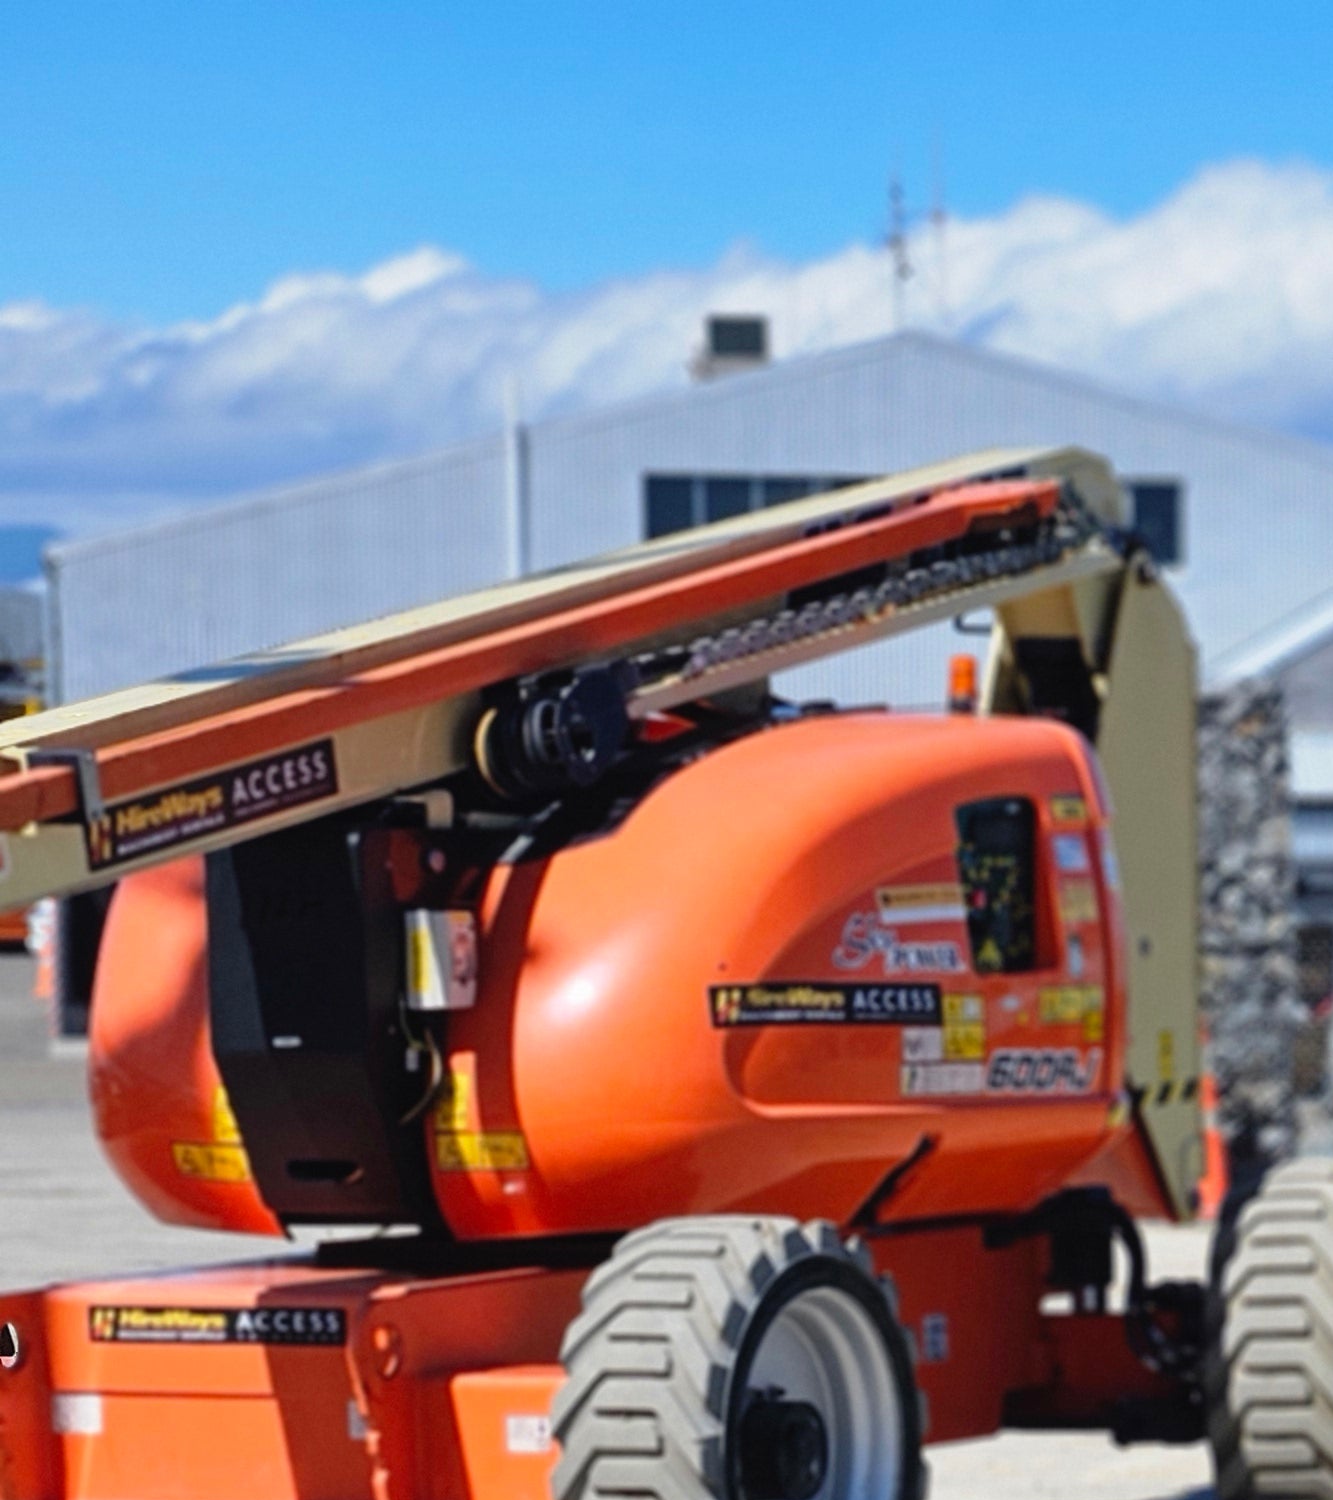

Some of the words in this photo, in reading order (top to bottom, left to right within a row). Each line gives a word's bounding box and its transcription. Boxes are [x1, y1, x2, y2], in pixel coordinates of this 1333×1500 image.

[232, 750, 328, 805] ACCESS
[853, 988, 935, 1011] ACCESS
[236, 1307, 340, 1331] ACCESS
